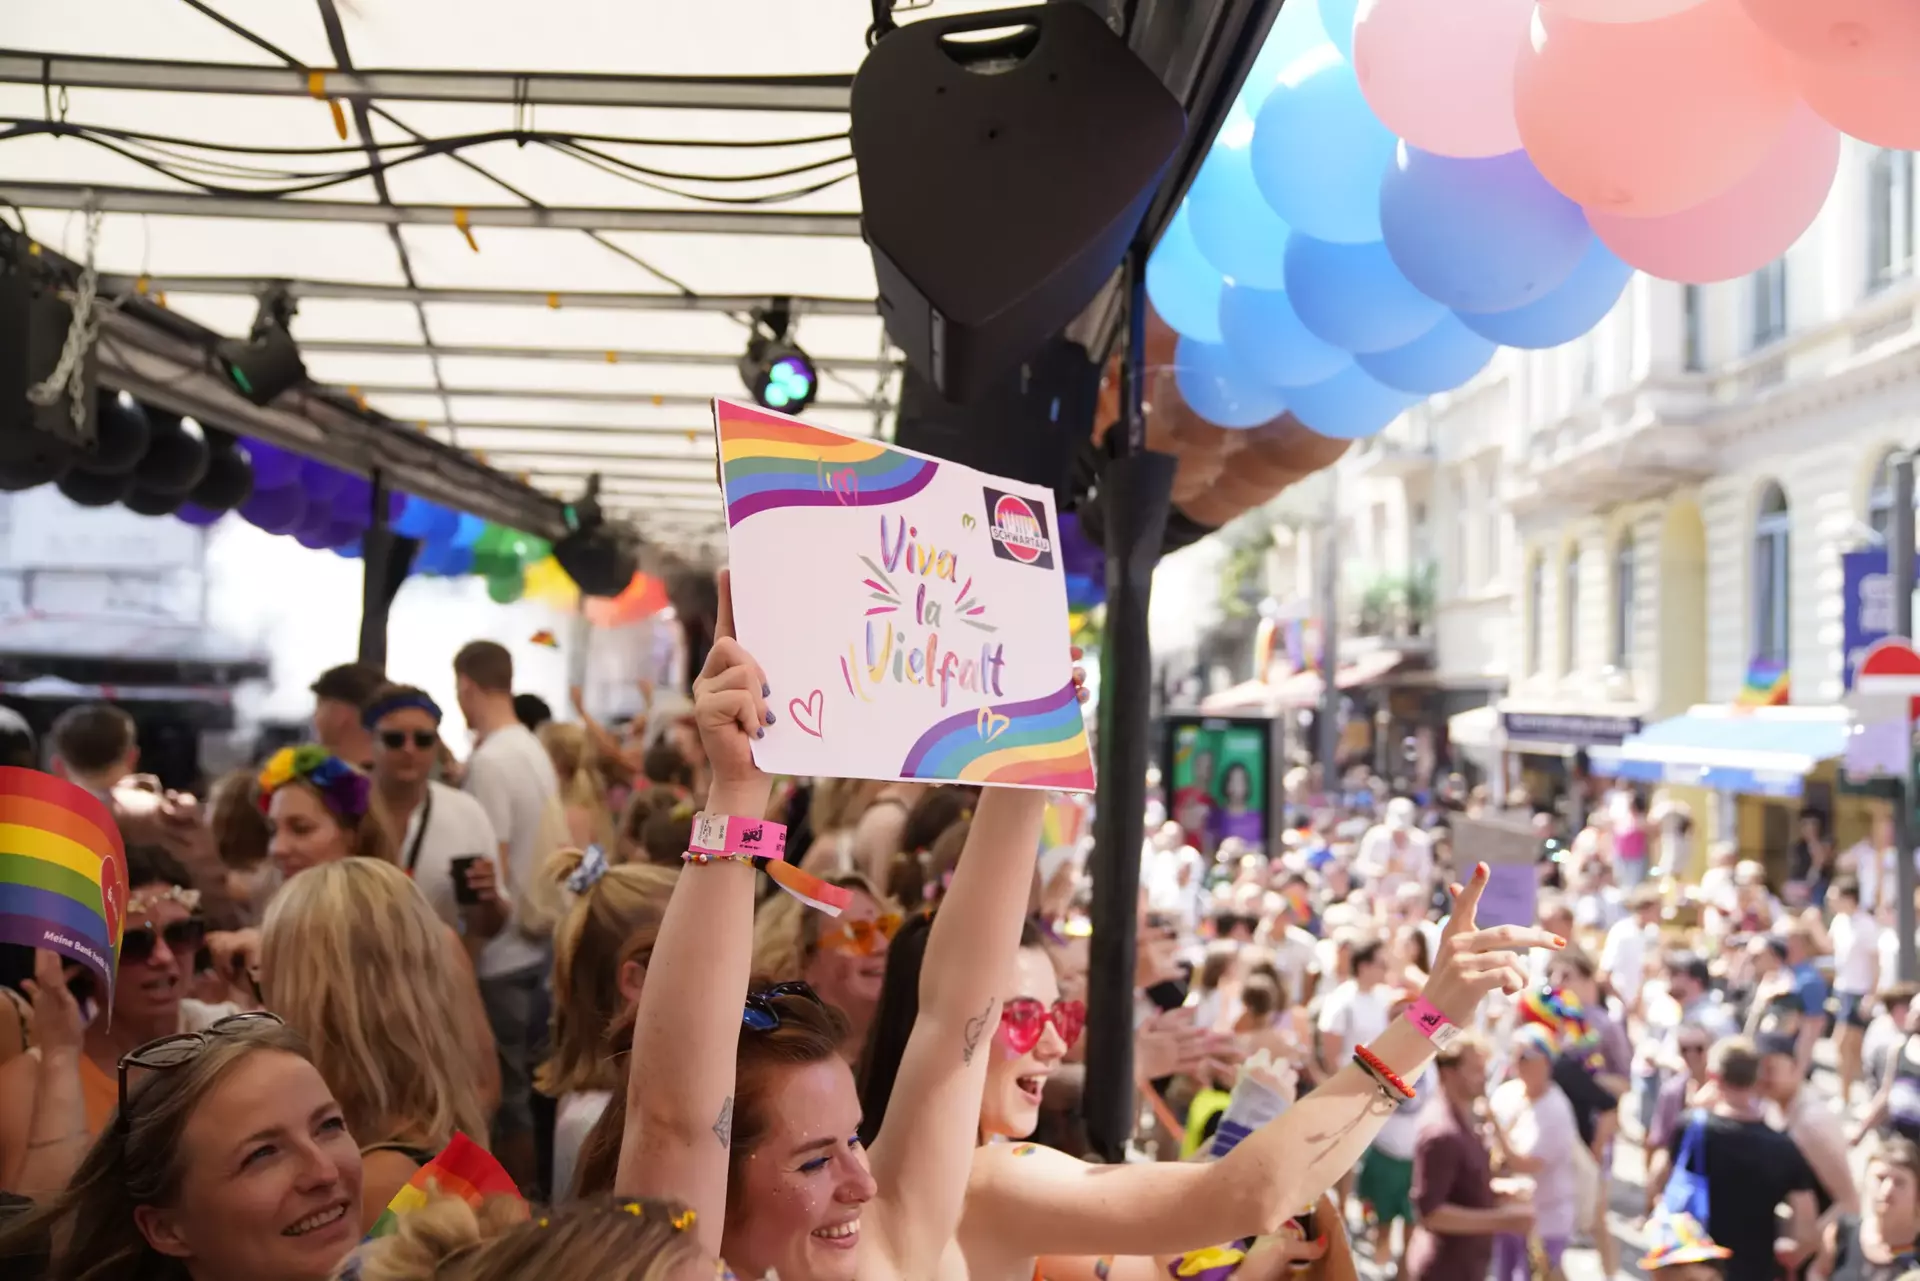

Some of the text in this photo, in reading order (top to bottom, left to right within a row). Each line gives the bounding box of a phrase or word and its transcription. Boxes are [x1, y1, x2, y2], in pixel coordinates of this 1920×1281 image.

[880, 514, 957, 583] Viva
[993, 528, 1048, 550] SCHWARTAU
[916, 583, 941, 627] la
[866, 620, 1006, 707] Vielfalt
[43, 930, 73, 948] Meine
[74, 941, 93, 957] Bank
